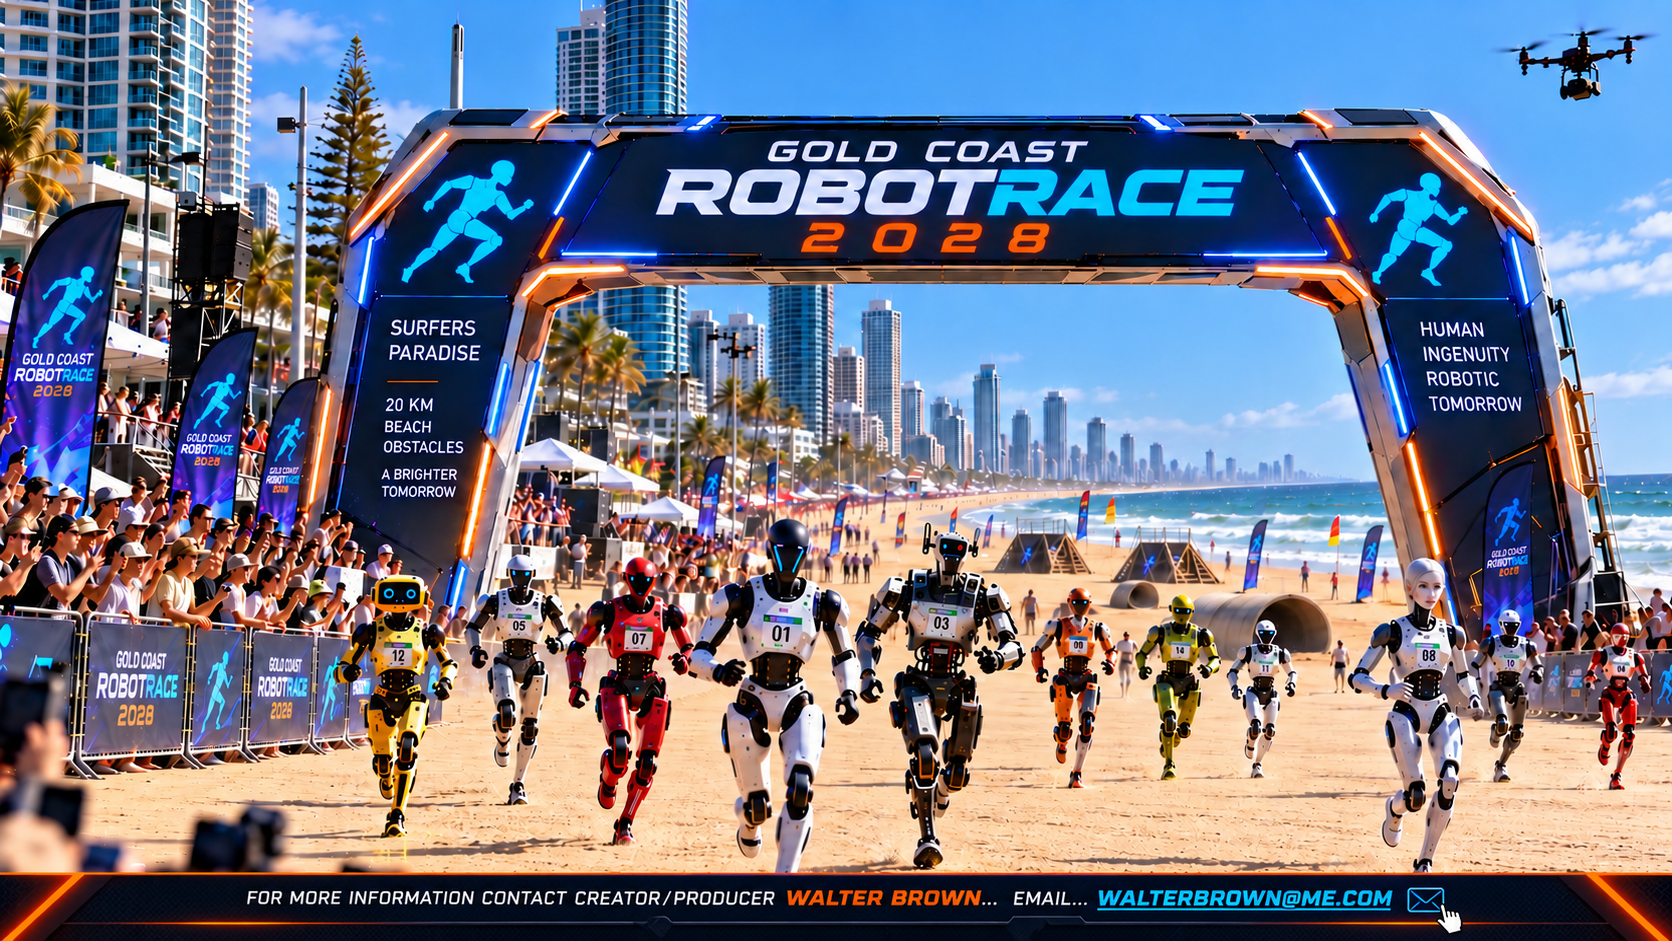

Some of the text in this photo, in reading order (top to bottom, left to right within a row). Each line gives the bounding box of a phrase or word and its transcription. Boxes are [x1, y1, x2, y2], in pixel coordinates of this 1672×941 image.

[768, 140, 1089, 164] GOLD COAST
[655, 166, 1246, 218] ROBOTRACE
[800, 221, 1051, 254] 2028
[390, 319, 476, 337] SURFERS
[1419, 321, 1485, 338] HUMAN
[22, 353, 94, 366] GOLD COAST
[388, 344, 481, 362] PARADISE
[1422, 346, 1510, 363] INGENUITY
[14, 367, 95, 382] ROBOTRACE
[1426, 370, 1500, 387] ROBOTIC
[33, 385, 73, 397] 2028
[385, 397, 434, 412] 20 KM
[1428, 395, 1522, 412] TOMORROW
[384, 420, 432, 434] BEACH
[186, 433, 232, 443] GOLD COAST
[383, 440, 464, 454] OBSTACLES
[381, 468, 458, 481] A BRIGHTER
[381, 485, 457, 498] TOMORROW
[512, 620, 526, 632] 05
[934, 616, 949, 630] 03
[632, 632, 646, 645] 07
[772, 625, 790, 642] 01
[116, 650, 167, 670] GOLD COAST
[392, 649, 405, 662] 12
[95, 672, 179, 699] ROBOTRACE
[257, 676, 308, 698] ROBOTRACE
[117, 704, 155, 726] 2028
[270, 701, 293, 720] 2028
